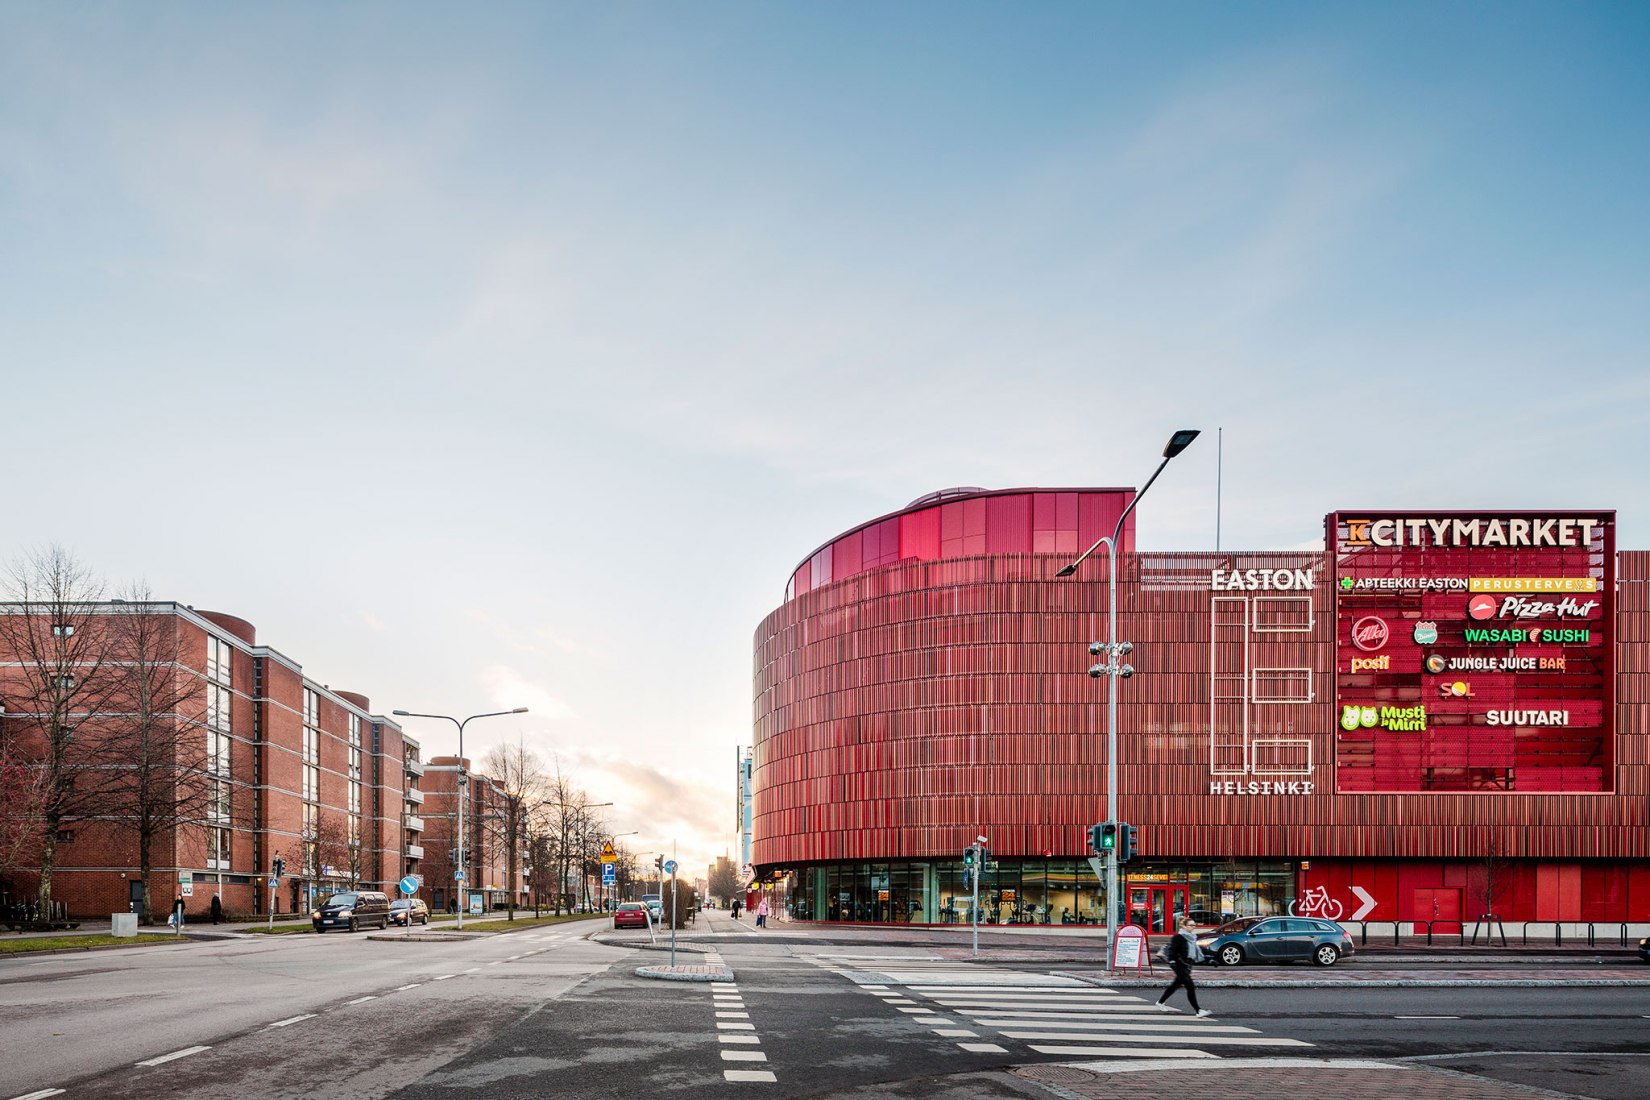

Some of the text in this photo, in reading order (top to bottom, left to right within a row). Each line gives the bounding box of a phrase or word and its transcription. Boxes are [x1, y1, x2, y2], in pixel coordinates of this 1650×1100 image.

[1371, 519, 1598, 546] CITYMARKET
[1212, 569, 1313, 590] EASTON
[1355, 578, 1468, 588] APTEEKKI EASTON
[1499, 596, 1599, 618] Pizza Hut
[1357, 624, 1386, 642] Alko
[1464, 629, 1590, 642] WASABI SUSHI
[1351, 655, 1390, 673] posti
[1448, 657, 1565, 669] JUNGLE JUICE BAR
[1381, 705, 1426, 718] Musti
[1486, 710, 1569, 725] SUUTARI
[1389, 717, 1426, 731] Mirri
[1210, 781, 1313, 795] HELSINKI
[605, 864, 613, 874] P
